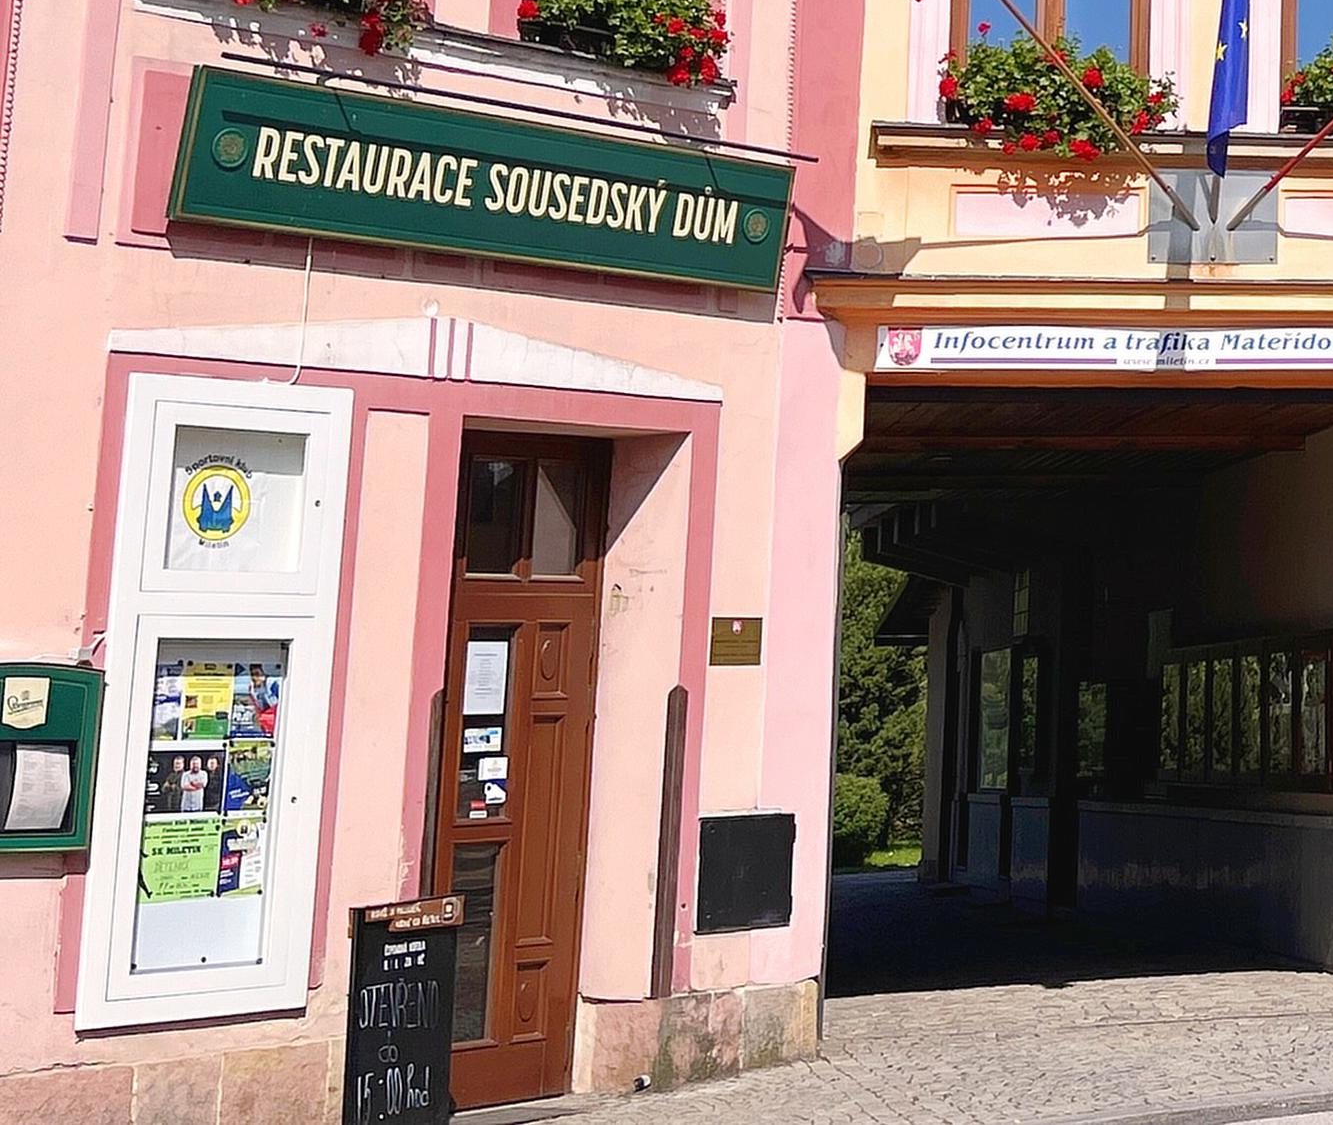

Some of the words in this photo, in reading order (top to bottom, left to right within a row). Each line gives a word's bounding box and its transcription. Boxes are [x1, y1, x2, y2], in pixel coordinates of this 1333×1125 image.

[252, 126, 478, 207] RESTAURACE
[484, 162, 668, 233] SOUSEDSKÝ
[672, 186, 738, 244] DŮM
[933, 331, 1094, 353] Infocentrum
[1103, 335, 1117, 350] a
[1125, 331, 1209, 353] trafika
